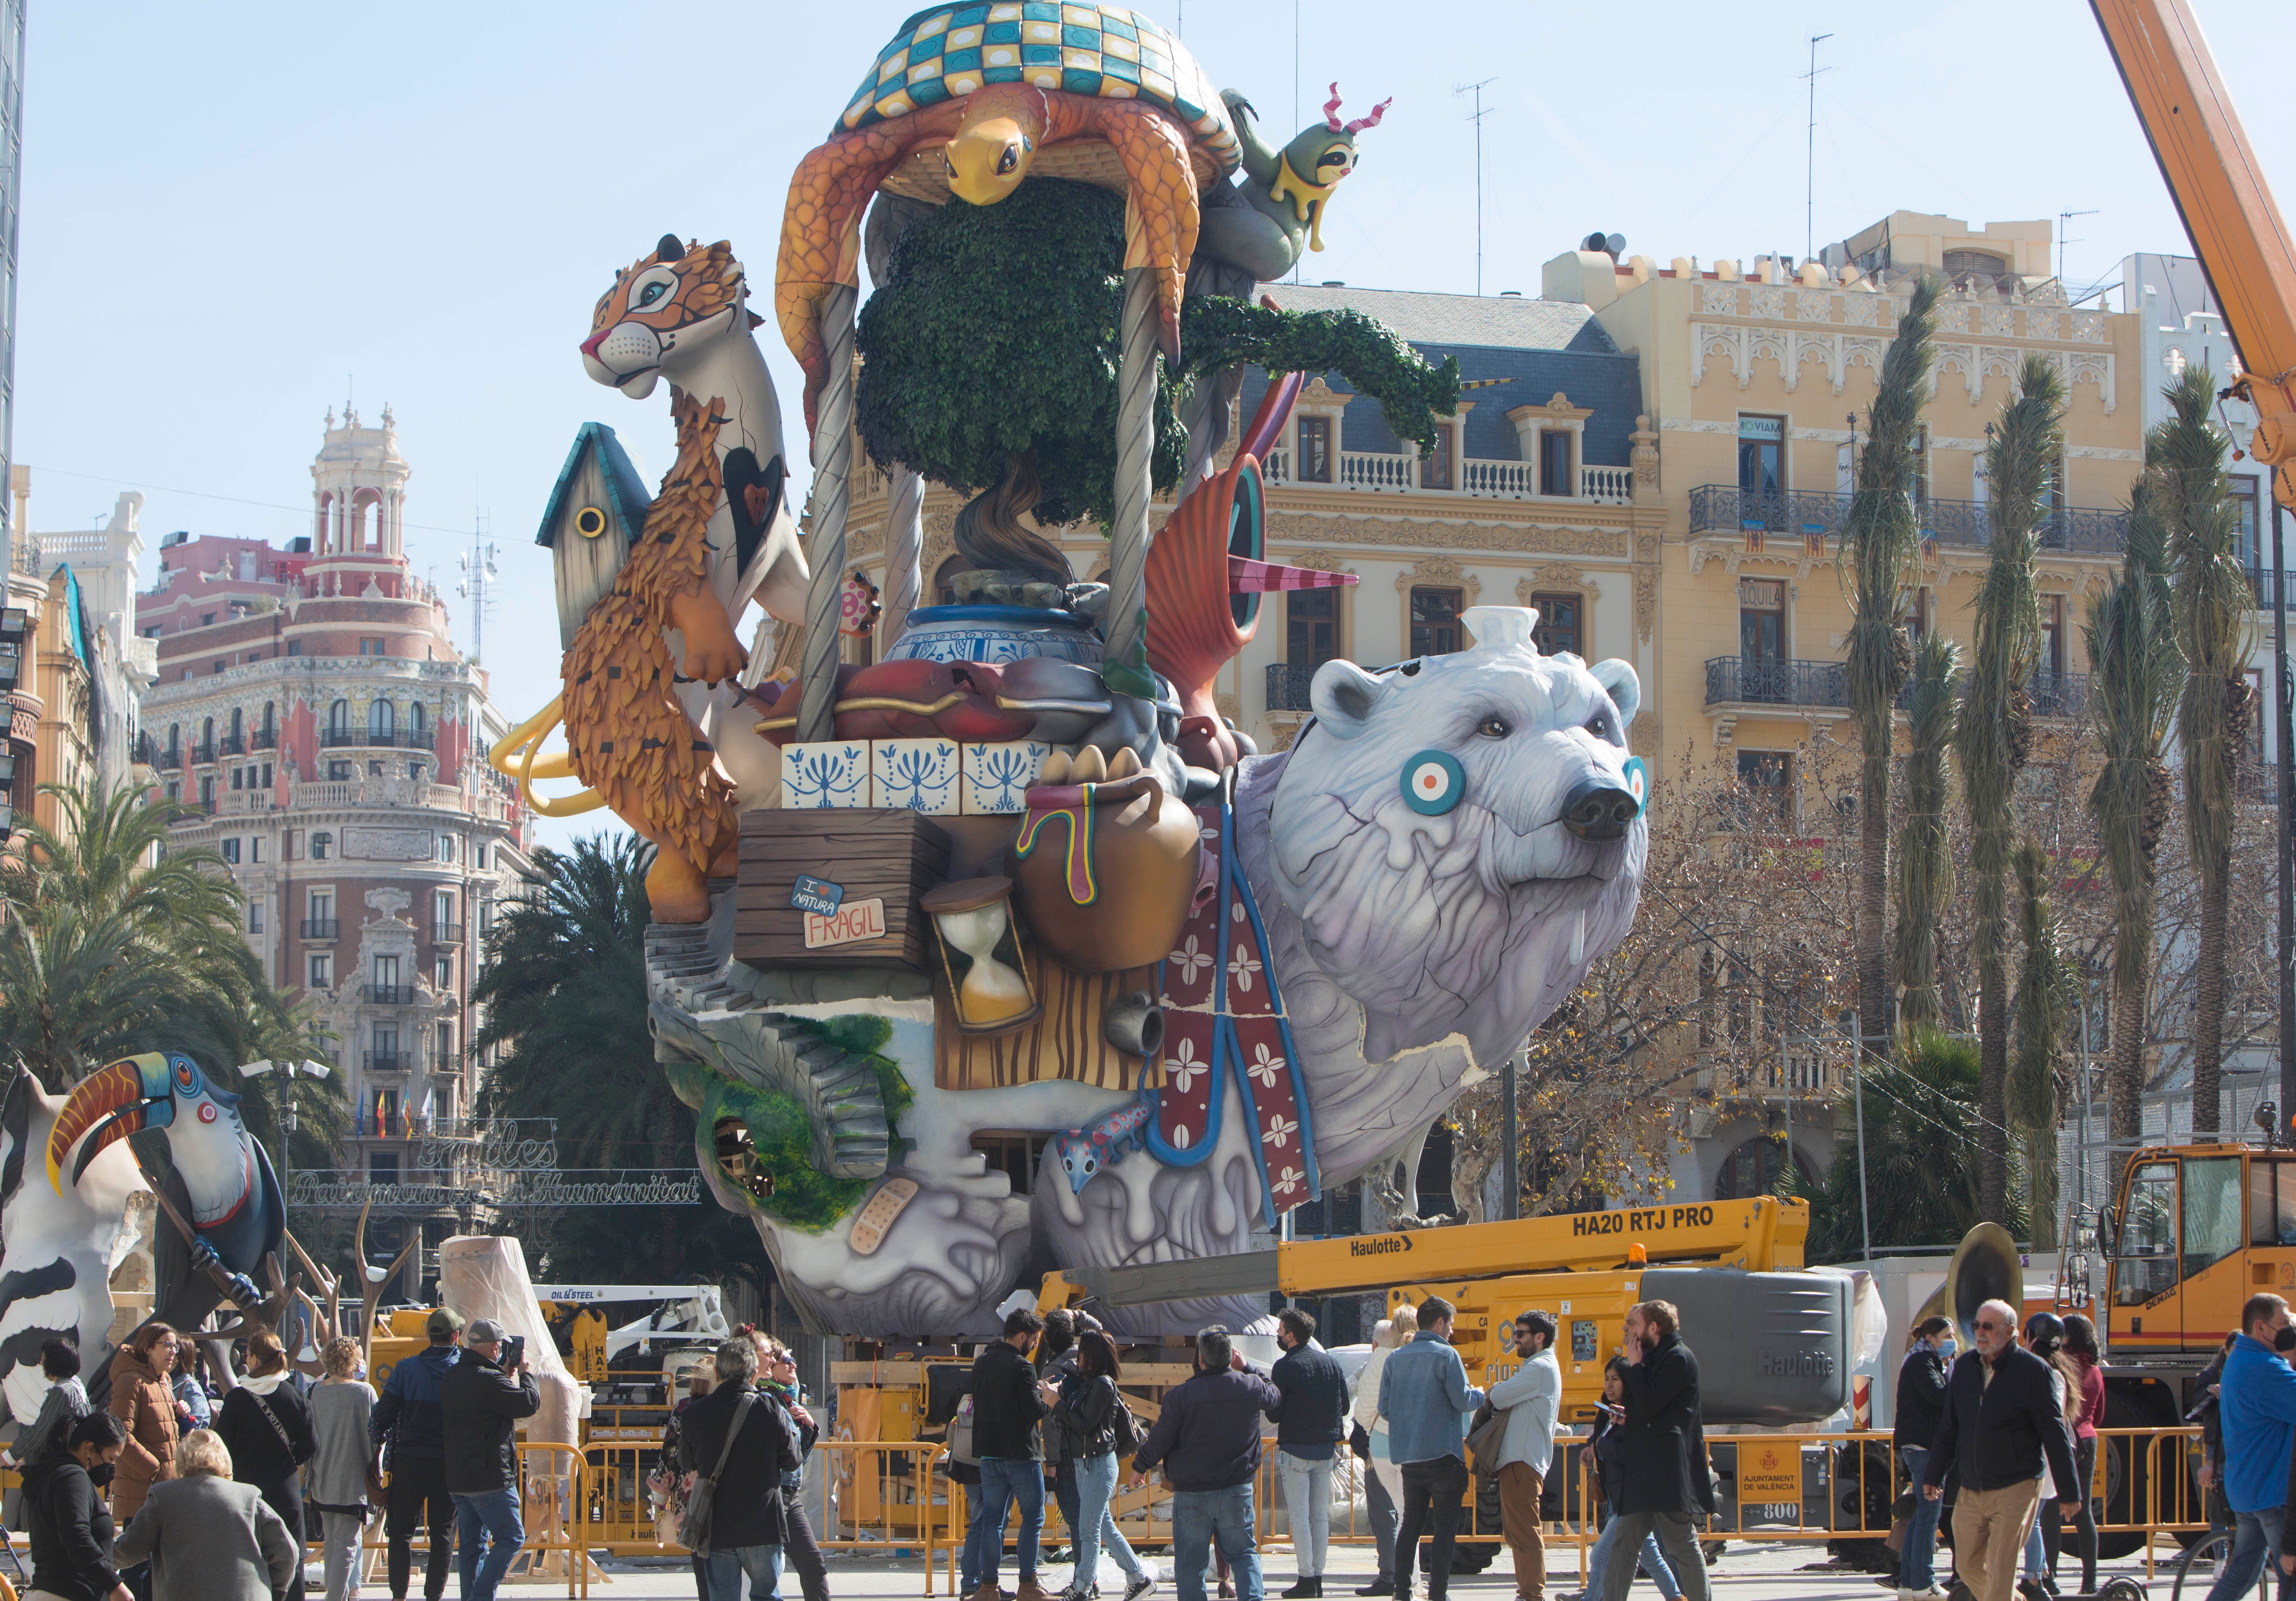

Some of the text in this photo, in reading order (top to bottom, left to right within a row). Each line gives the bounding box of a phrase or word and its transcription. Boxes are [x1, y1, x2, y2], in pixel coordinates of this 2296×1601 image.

[2258, 426, 2271, 454] DEMAG
[2281, 468, 2294, 496] DEMAG
[1741, 586, 1781, 606] LQUILA
[803, 879, 817, 892] I
[794, 893, 834, 915] NATURA
[810, 906, 883, 943] FRAGIL
[417, 1120, 558, 1167] Falles
[292, 1172, 445, 1205] Patrimoni
[530, 1171, 699, 1203] Humanitat
[1573, 1206, 1713, 1236] HA20 RTJ PRO
[1351, 1238, 1401, 1257] Haulotte
[2145, 1287, 2176, 1310] DEMAG
[1757, 1350, 1834, 1376] Haulotte
[1764, 1502, 1797, 1519] 800
